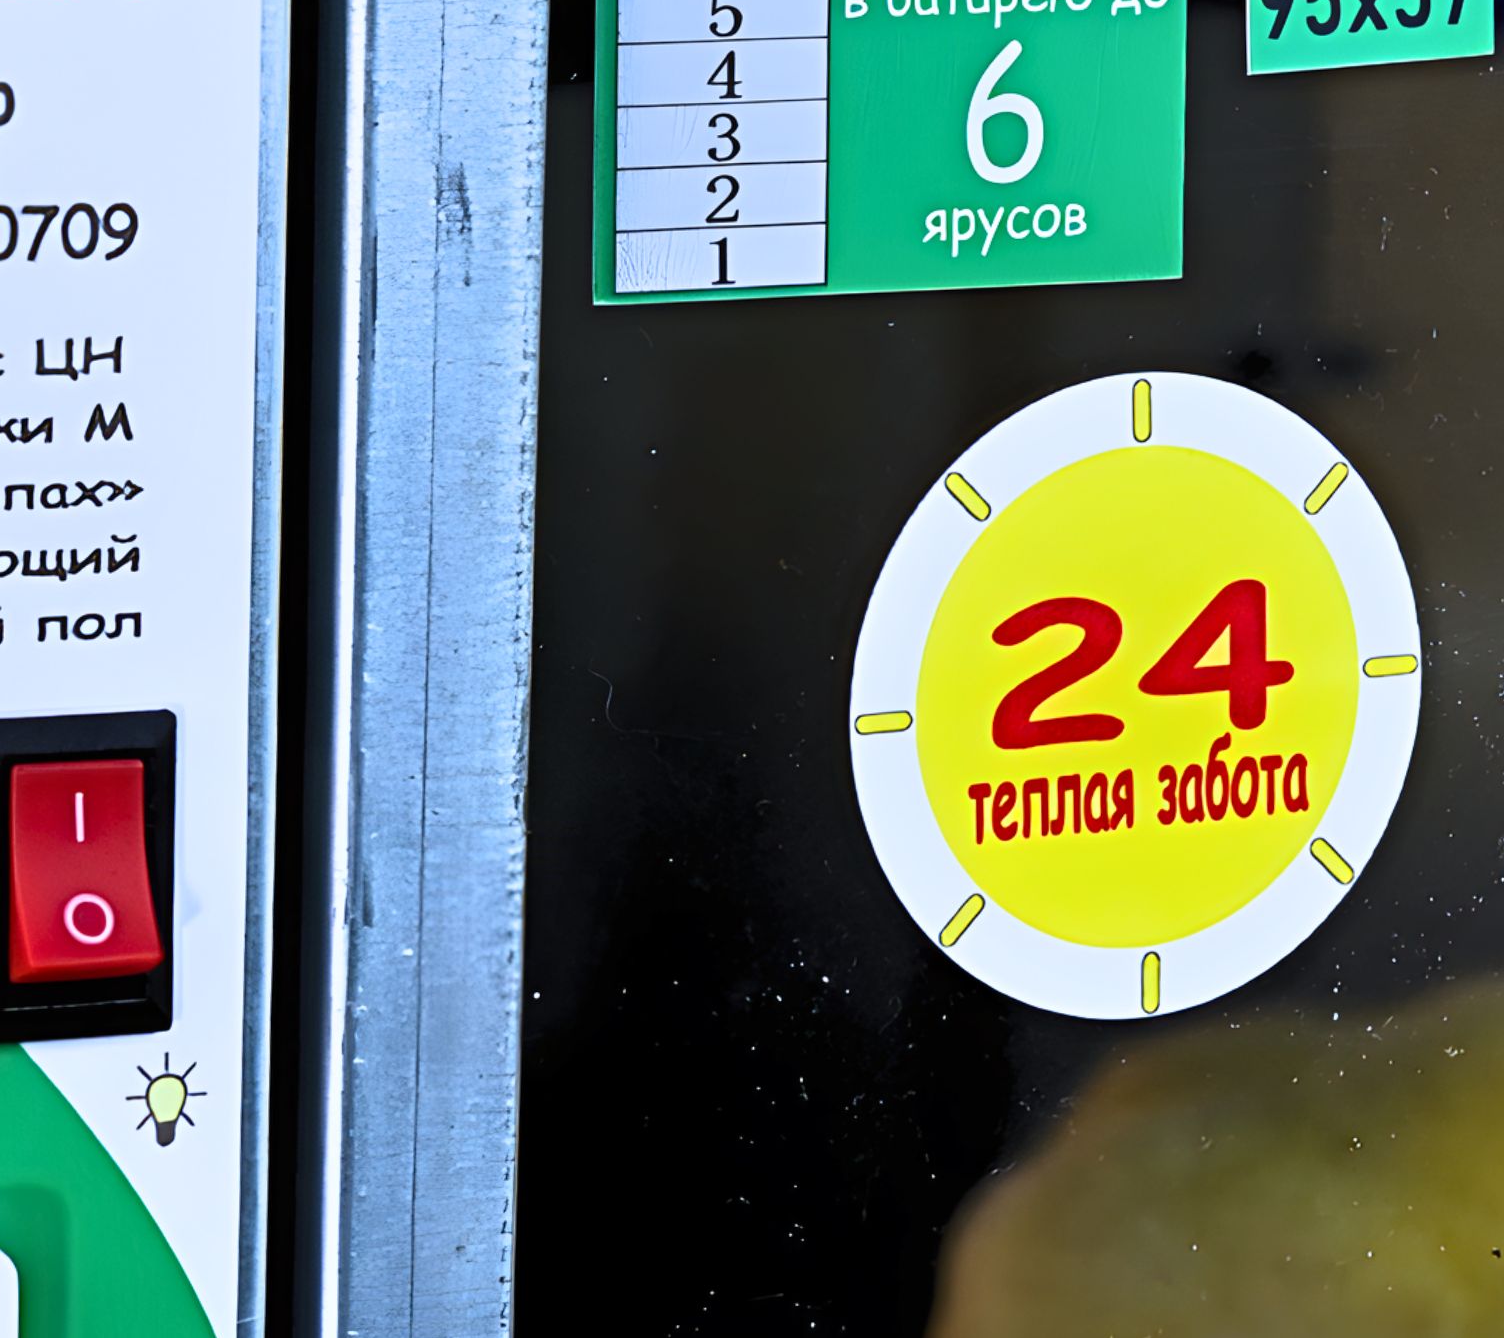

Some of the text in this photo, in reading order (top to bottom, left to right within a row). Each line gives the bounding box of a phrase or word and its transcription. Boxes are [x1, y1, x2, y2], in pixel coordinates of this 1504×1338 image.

[706, 51, 743, 100] 4
[965, 38, 1045, 184] 6
[707, 112, 742, 162] 3
[705, 175, 741, 225] 2
[922, 198, 1088, 258] ярусов
[710, 238, 734, 287] 1
[34, 336, 124, 378] ЦН
[84, 402, 132, 442] М
[38, 610, 143, 643] пол
[991, 578, 1295, 750] 24
[968, 732, 1309, 848] теплая забота
